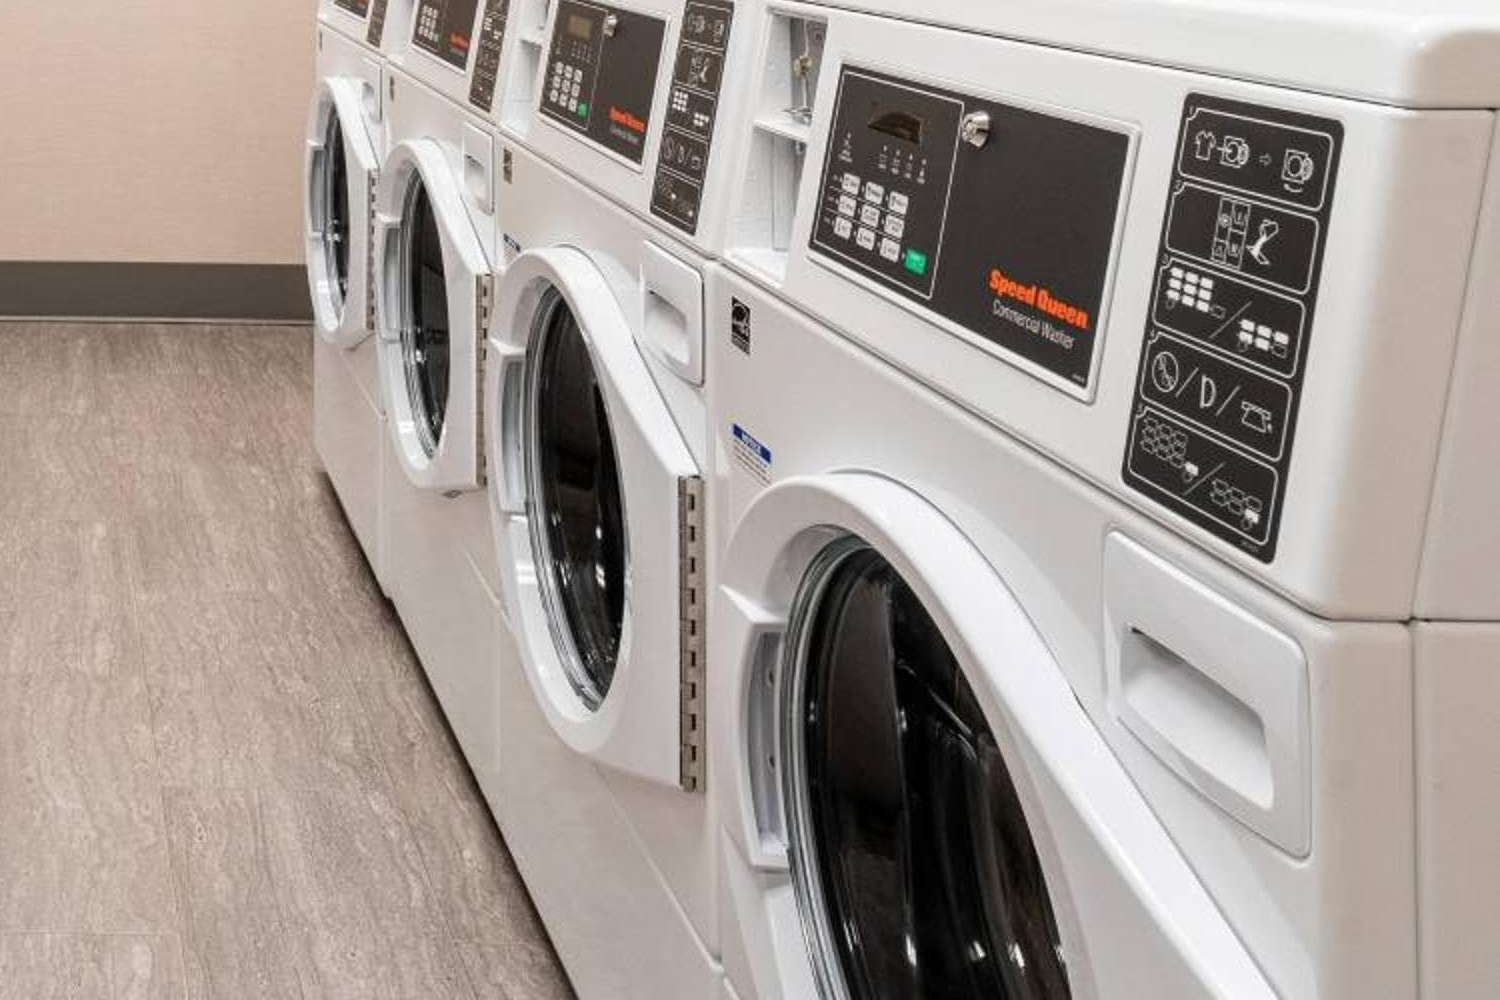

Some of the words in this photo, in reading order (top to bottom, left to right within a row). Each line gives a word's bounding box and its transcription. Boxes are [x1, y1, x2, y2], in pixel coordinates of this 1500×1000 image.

[989, 268, 1037, 306] Speed
[1037, 289, 1088, 329] Queen
[993, 299, 1040, 334] Commercial
